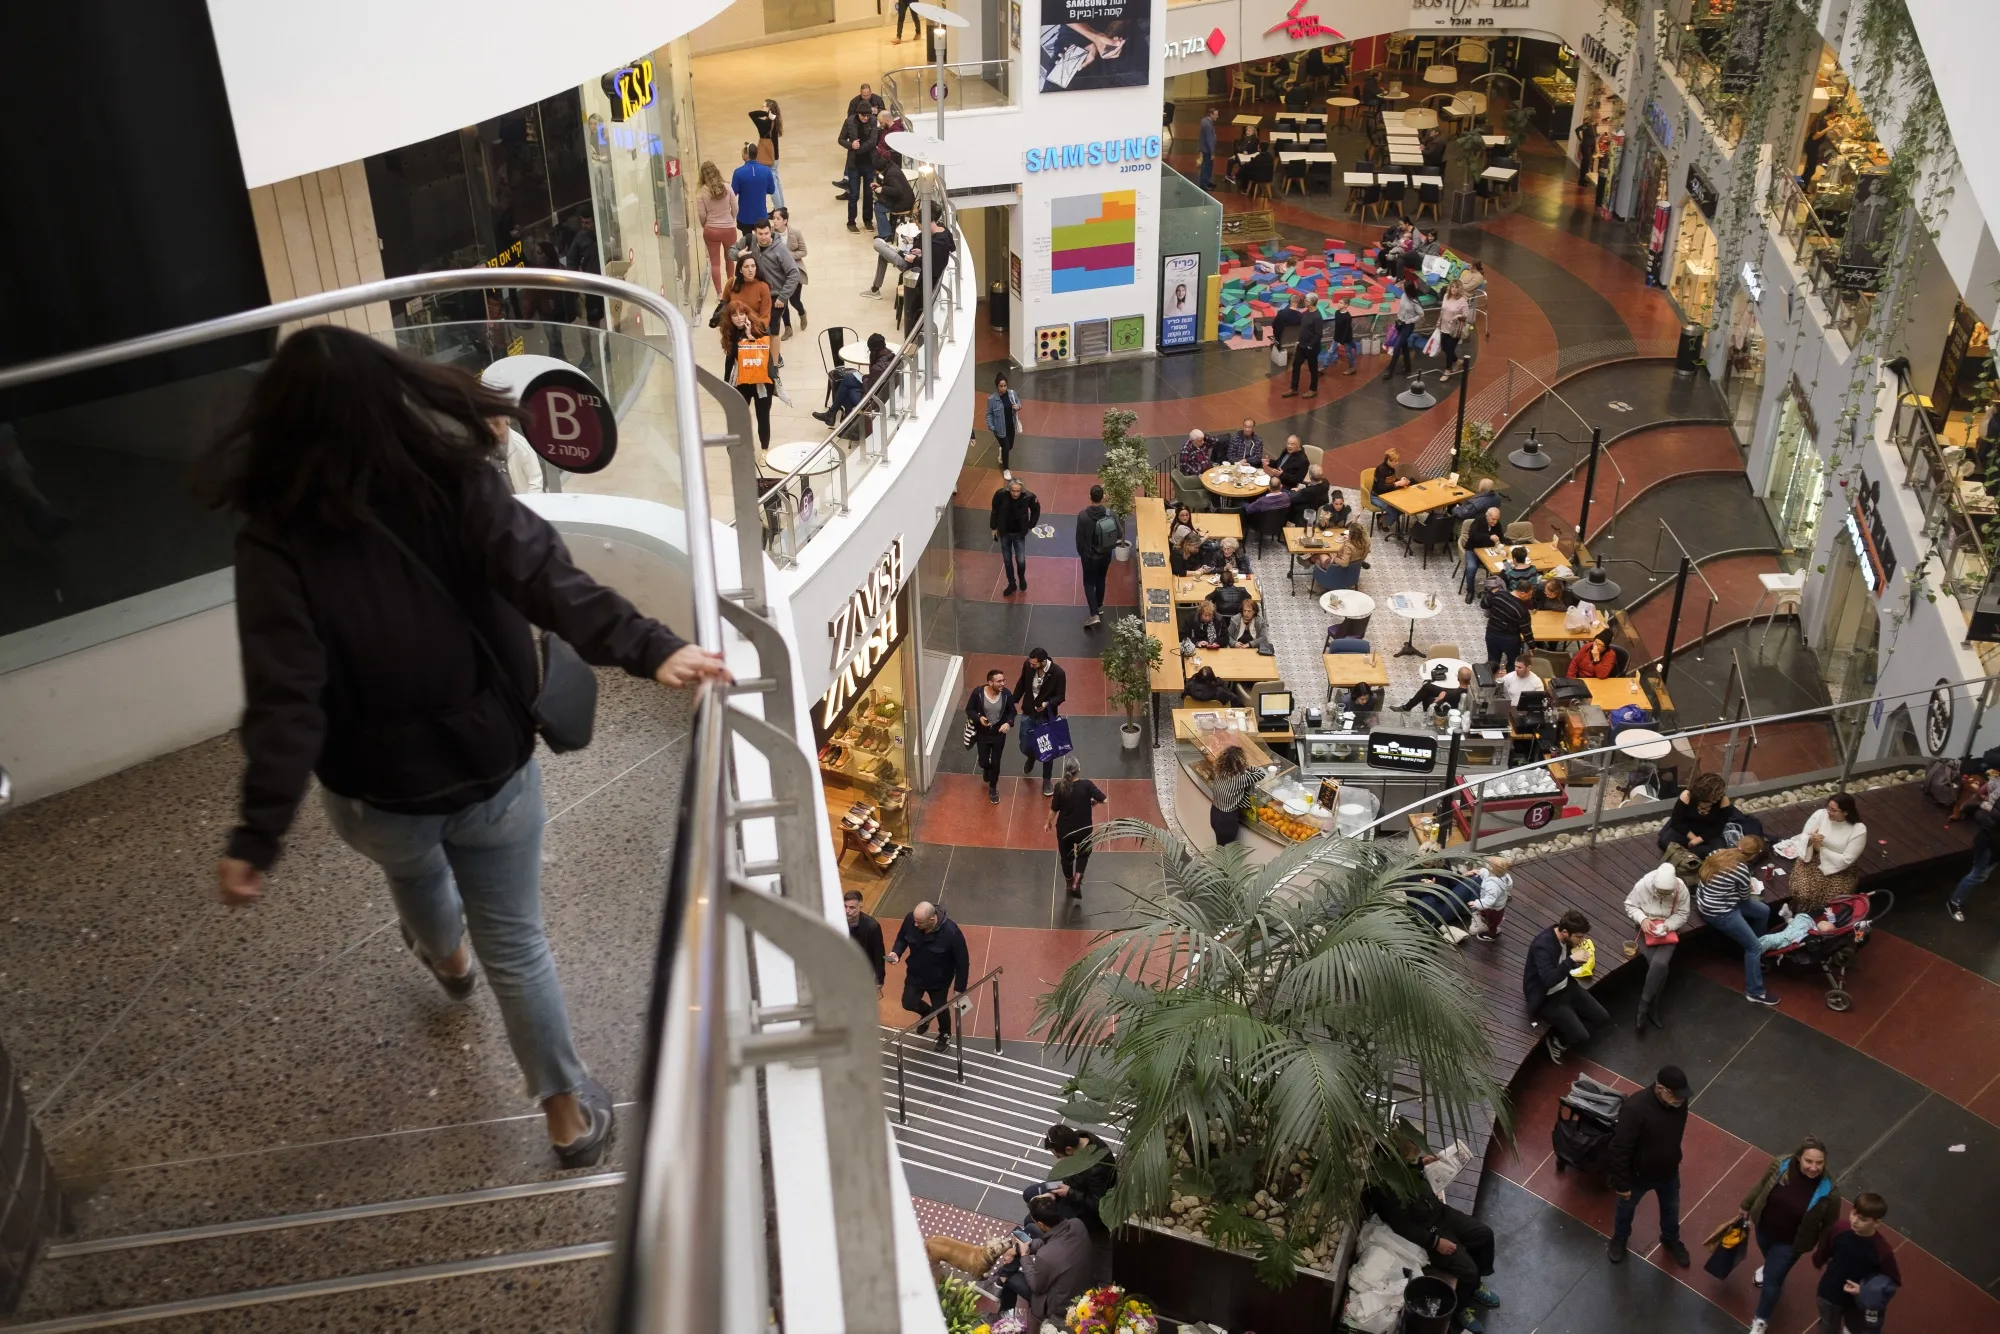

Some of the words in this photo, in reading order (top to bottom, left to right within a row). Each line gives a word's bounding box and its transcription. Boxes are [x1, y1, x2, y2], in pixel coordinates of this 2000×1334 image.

[1069, 9, 1076, 18] B
[1104, 8, 1123, 17] קומה
[1450, 16, 1472, 26] אוכל
[1182, 36, 1206, 59] בנק
[1025, 135, 1160, 173] SAMSUNG
[1120, 163, 1152, 173] סמסונג
[1172, 259, 1194, 268] פריד
[577, 393, 602, 408] בניין
[545, 391, 582, 441] B
[547, 444, 557, 455] 2
[559, 444, 590, 460] קומה
[1037, 734, 1049, 743] MY
[1532, 807, 1543, 823] B
